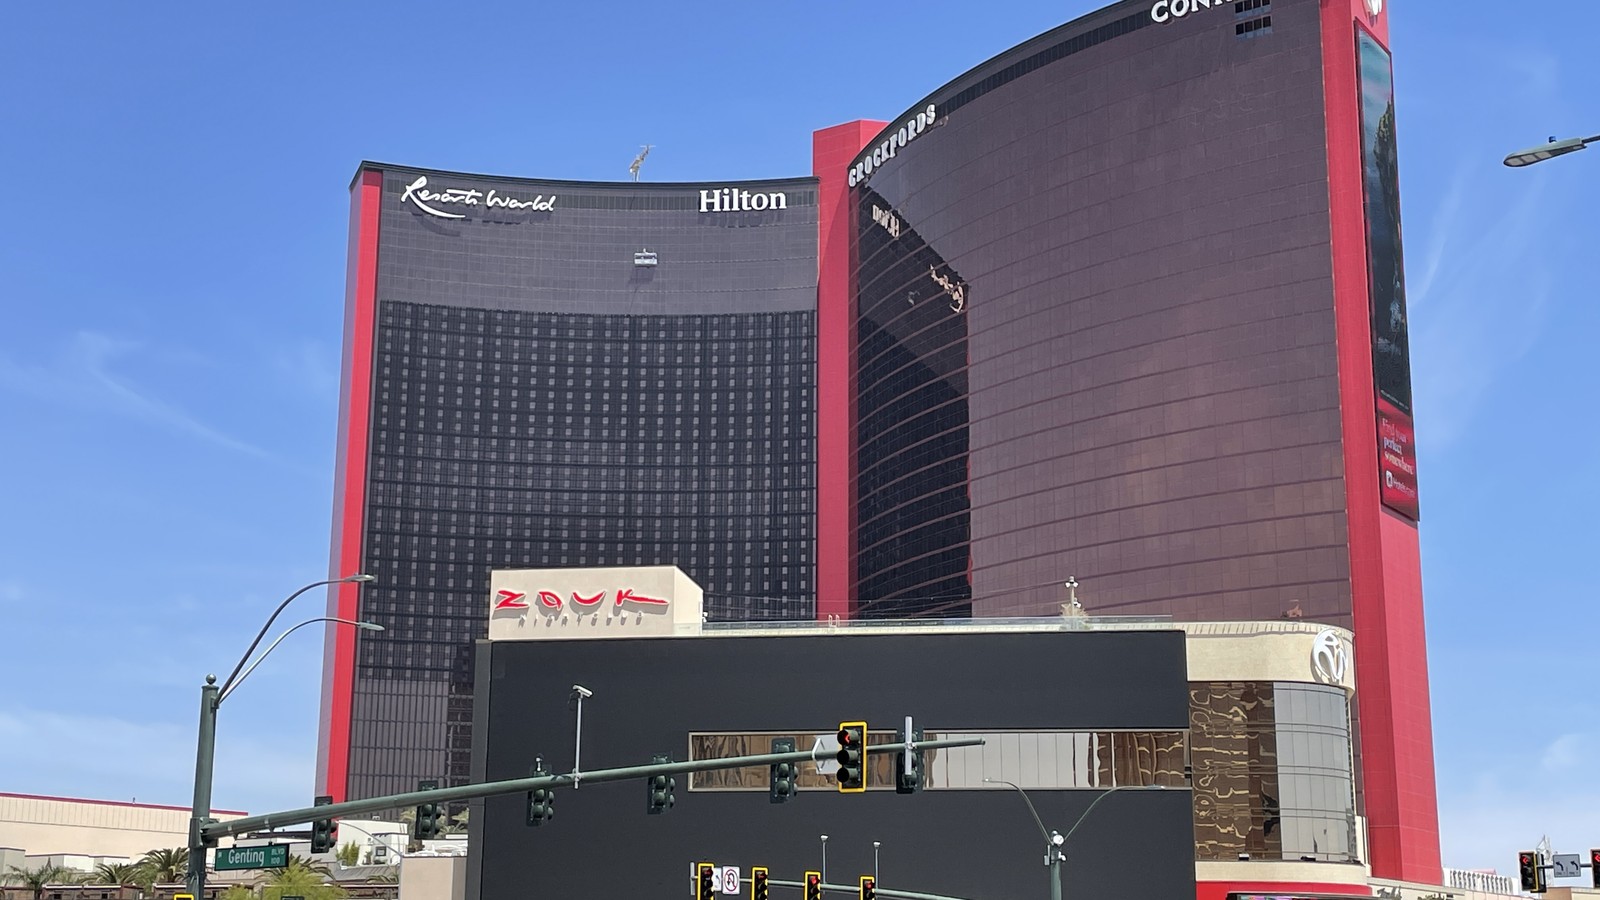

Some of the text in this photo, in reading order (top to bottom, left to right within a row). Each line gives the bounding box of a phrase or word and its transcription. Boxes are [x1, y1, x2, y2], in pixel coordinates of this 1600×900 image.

[1151, 0, 1233, 22] CON
[848, 104, 936, 187] CROCKFORDS
[401, 175, 556, 218] Resorts World
[699, 187, 788, 212] Hilton
[495, 588, 670, 611] ZOUK
[228, 849, 265, 867] Genting
[271, 847, 285, 856] BLVD
